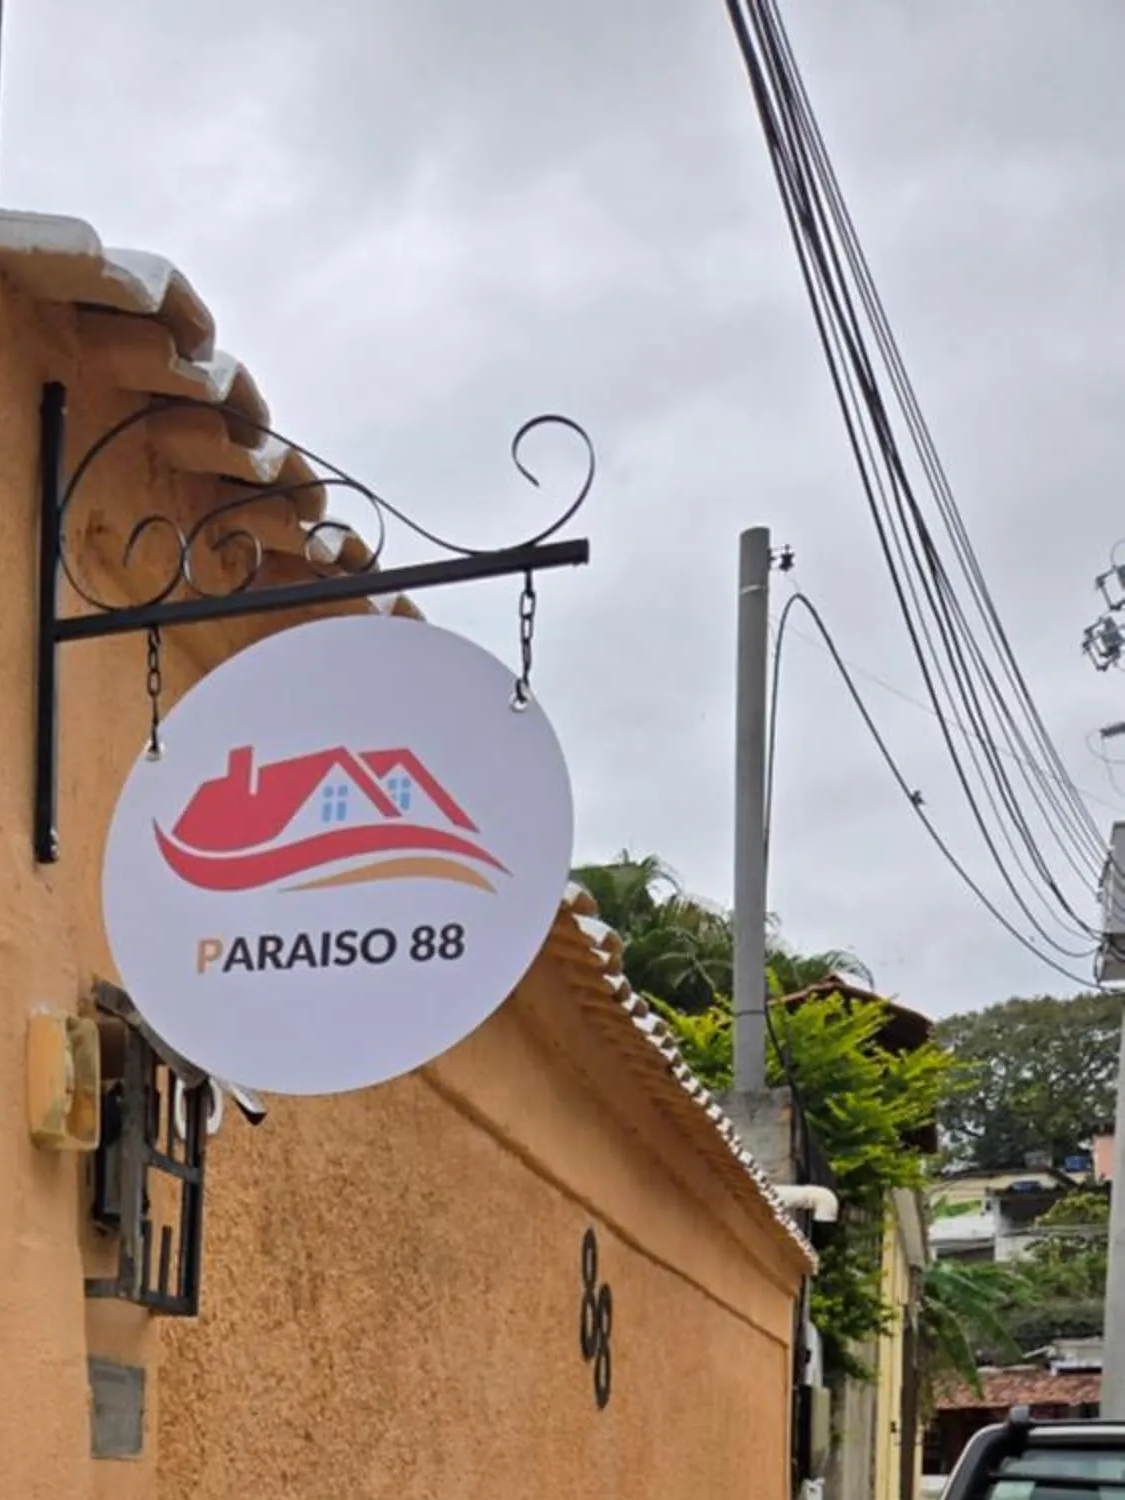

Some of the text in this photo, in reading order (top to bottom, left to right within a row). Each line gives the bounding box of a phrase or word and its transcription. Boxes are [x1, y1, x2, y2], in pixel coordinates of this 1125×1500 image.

[196, 922, 466, 975] PARAISO 88
[580, 1227, 612, 1411] 88
